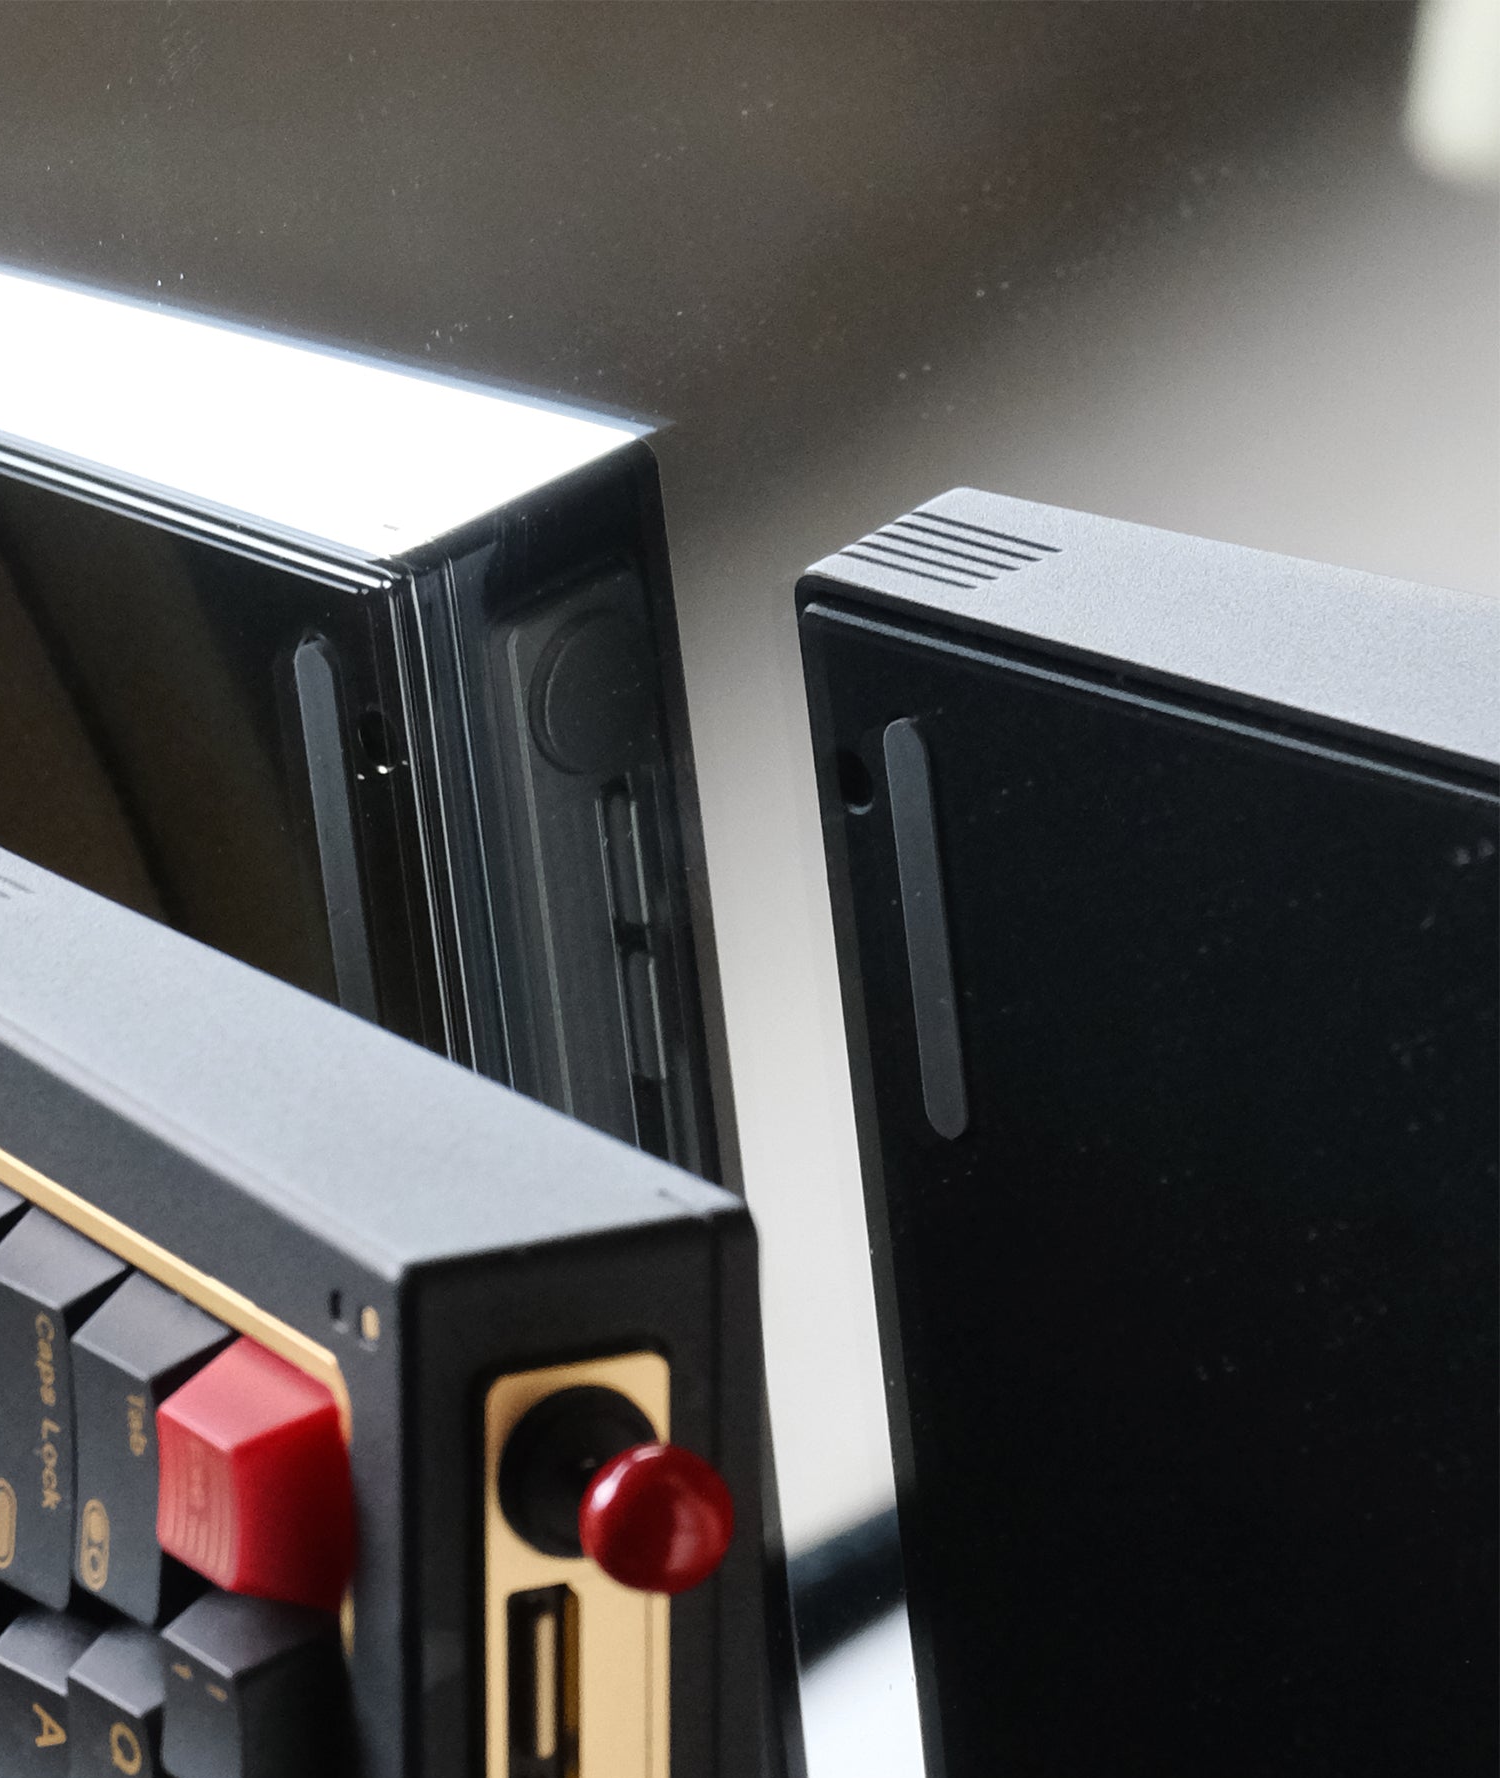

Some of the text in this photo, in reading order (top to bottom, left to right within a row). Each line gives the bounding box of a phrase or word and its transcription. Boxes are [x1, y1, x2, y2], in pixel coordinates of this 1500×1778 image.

[36, 1314, 61, 1509] Caps Lock
[128, 1396, 147, 1456] Tab
[33, 1704, 66, 1747] A
